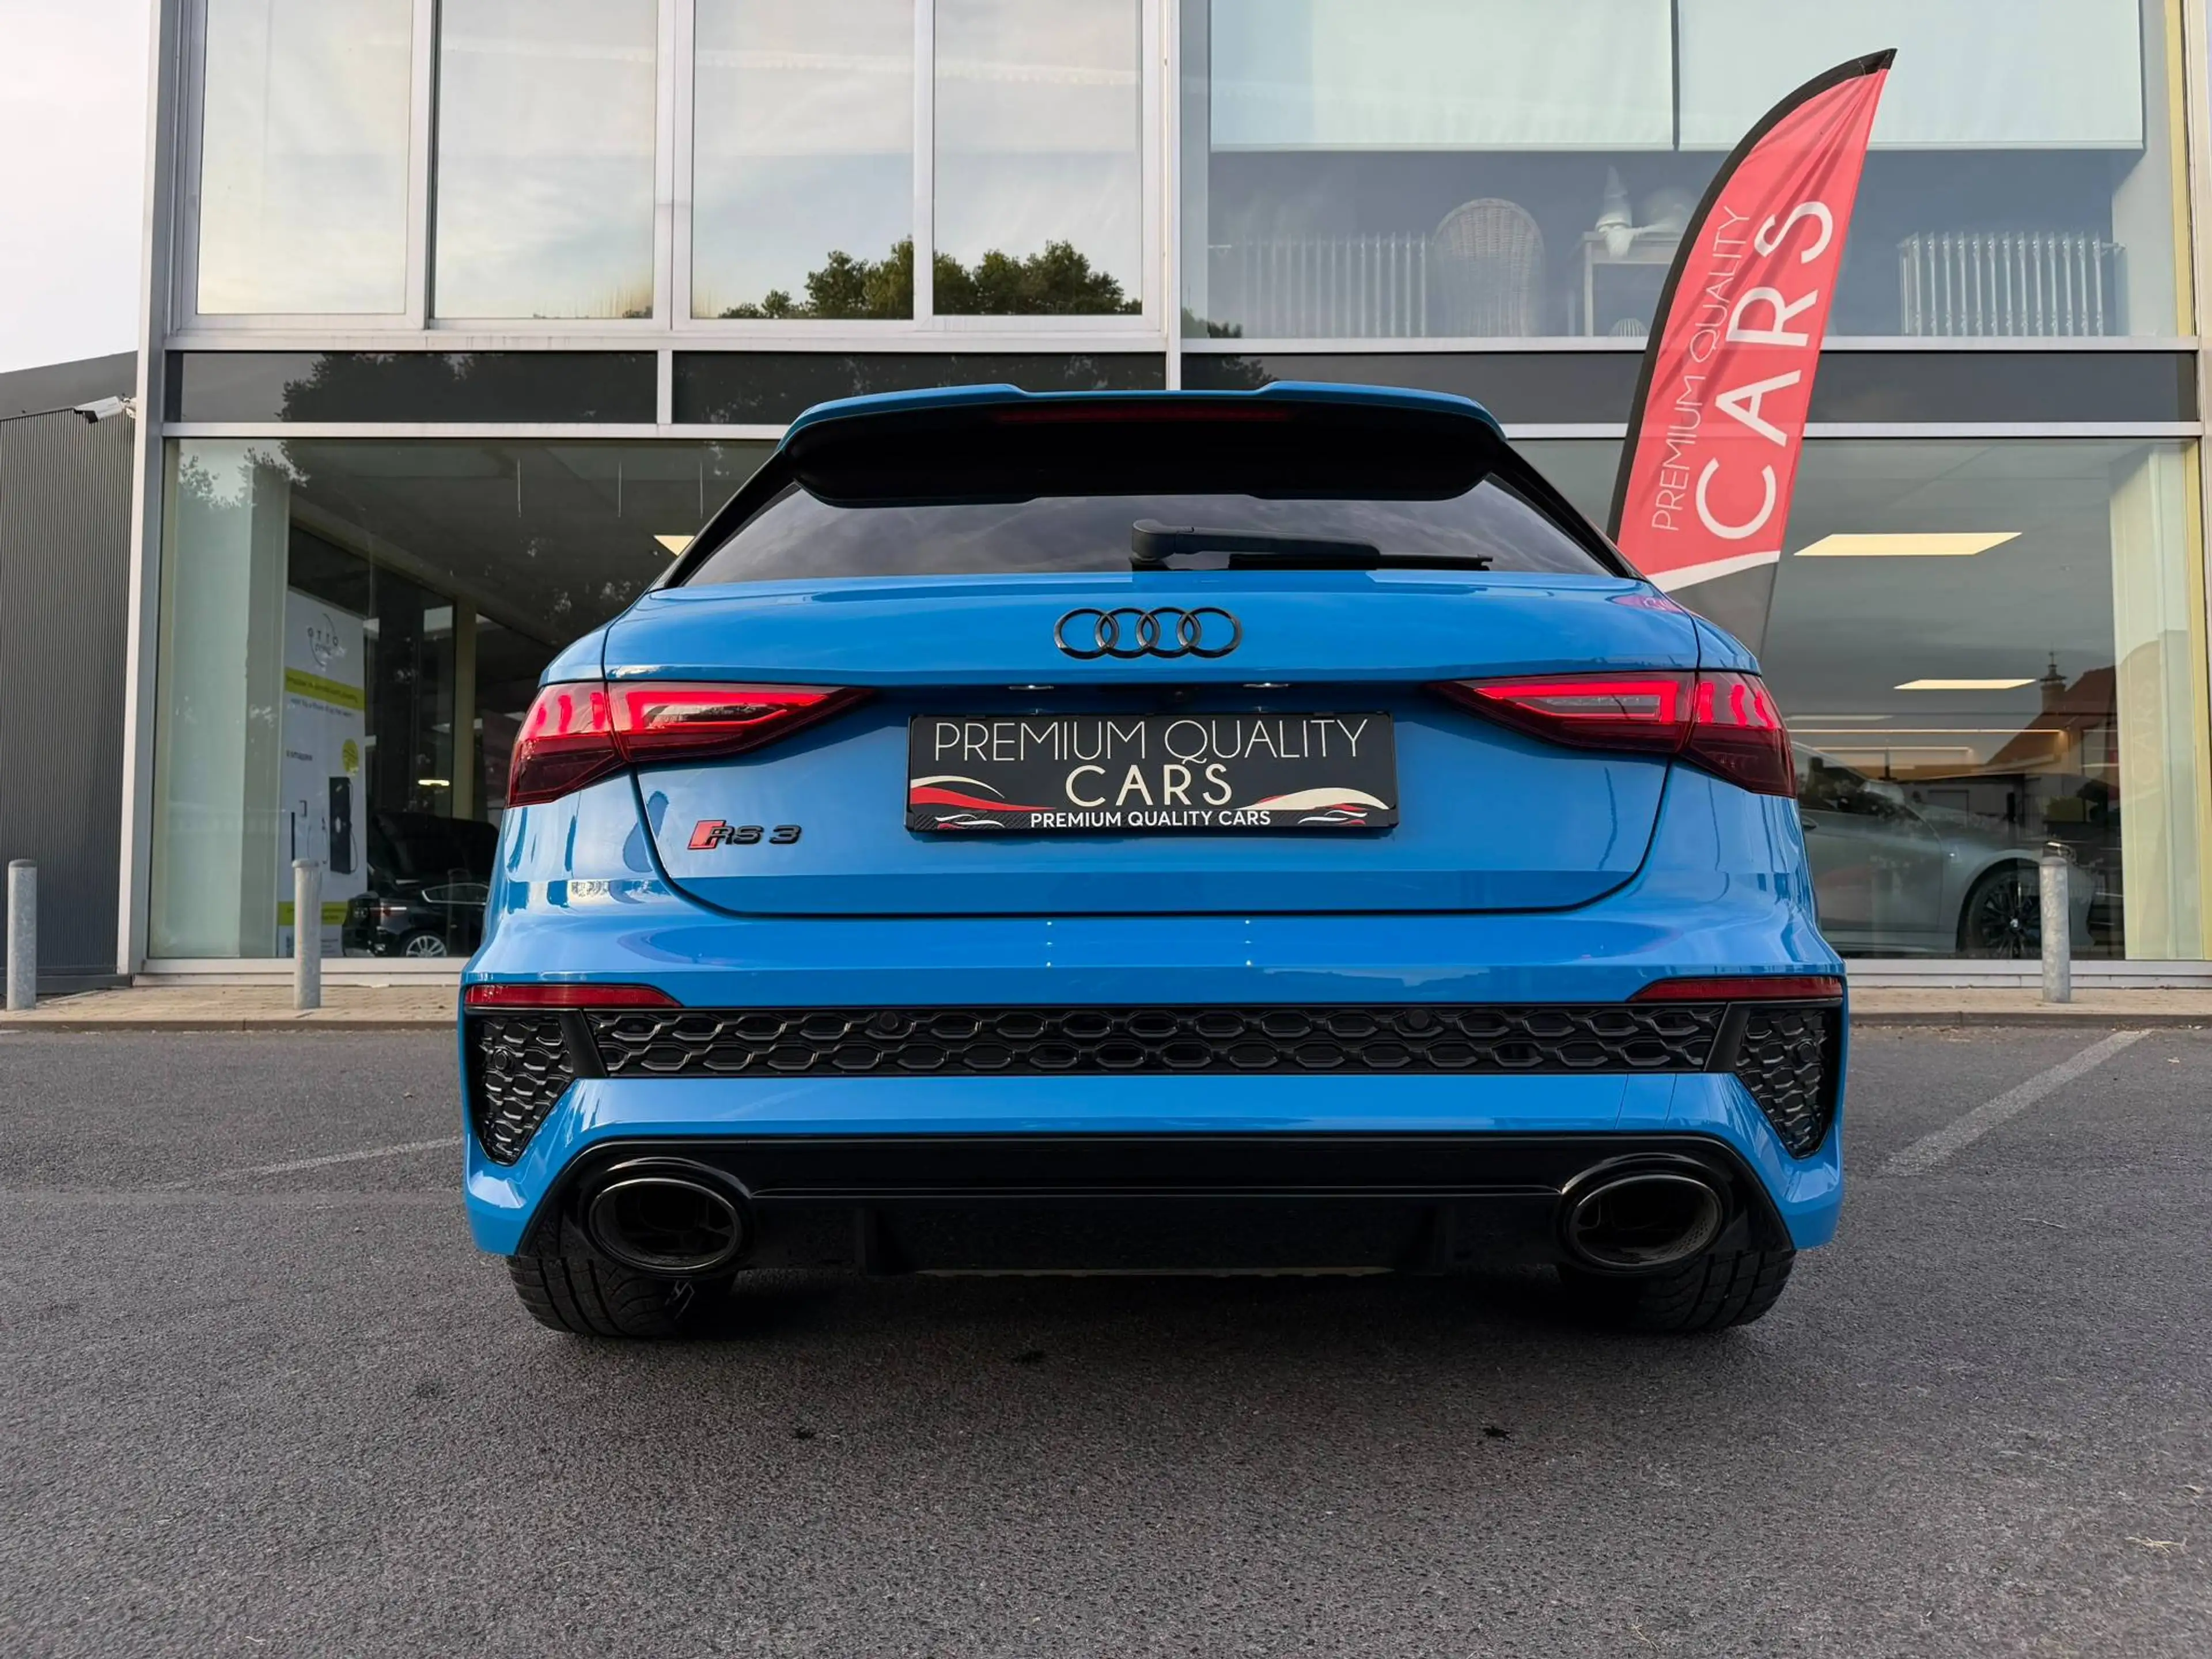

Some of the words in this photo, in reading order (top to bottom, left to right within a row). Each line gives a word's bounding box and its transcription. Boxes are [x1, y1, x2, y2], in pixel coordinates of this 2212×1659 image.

[1652, 374, 1706, 531] PREMIUM
[1690, 205, 1749, 363] QUALITY
[1696, 200, 1834, 540] CARS
[935, 721, 1145, 761] PREMIUM
[1164, 718, 1368, 763] QUALITY
[1066, 764, 1232, 806] CARS
[698, 822, 764, 846] RS
[769, 824, 802, 845] 3
[1031, 812, 1125, 828] PREMIUM
[1128, 812, 1214, 827] QUALITY
[1218, 810, 1271, 825] CARS
